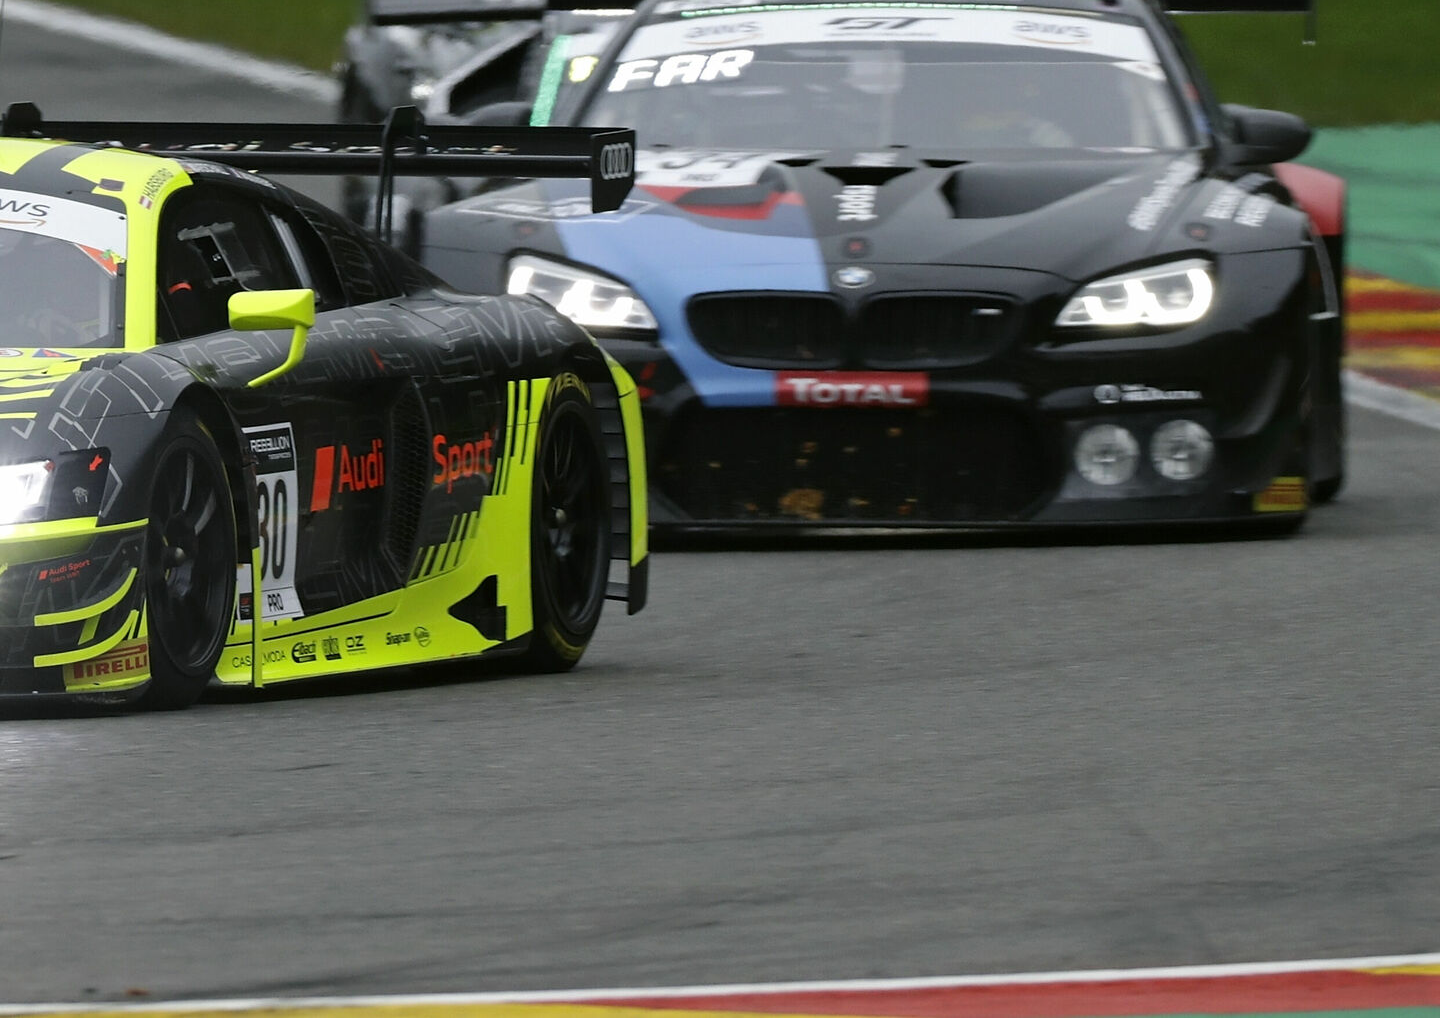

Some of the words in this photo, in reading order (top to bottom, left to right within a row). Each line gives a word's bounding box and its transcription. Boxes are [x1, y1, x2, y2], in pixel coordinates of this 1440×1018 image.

[823, 16, 954, 30] GT
[607, 49, 755, 92] FAR
[785, 377, 916, 404] TOTAL
[250, 435, 291, 453] REBELLION
[338, 438, 385, 494] Audi
[432, 432, 493, 494] Sport
[49, 566, 68, 577] Audi
[68, 559, 91, 572] Sport
[267, 594, 285, 613] PRO
[346, 635, 364, 649] OZ
[73, 644, 148, 680] PIRELLI
